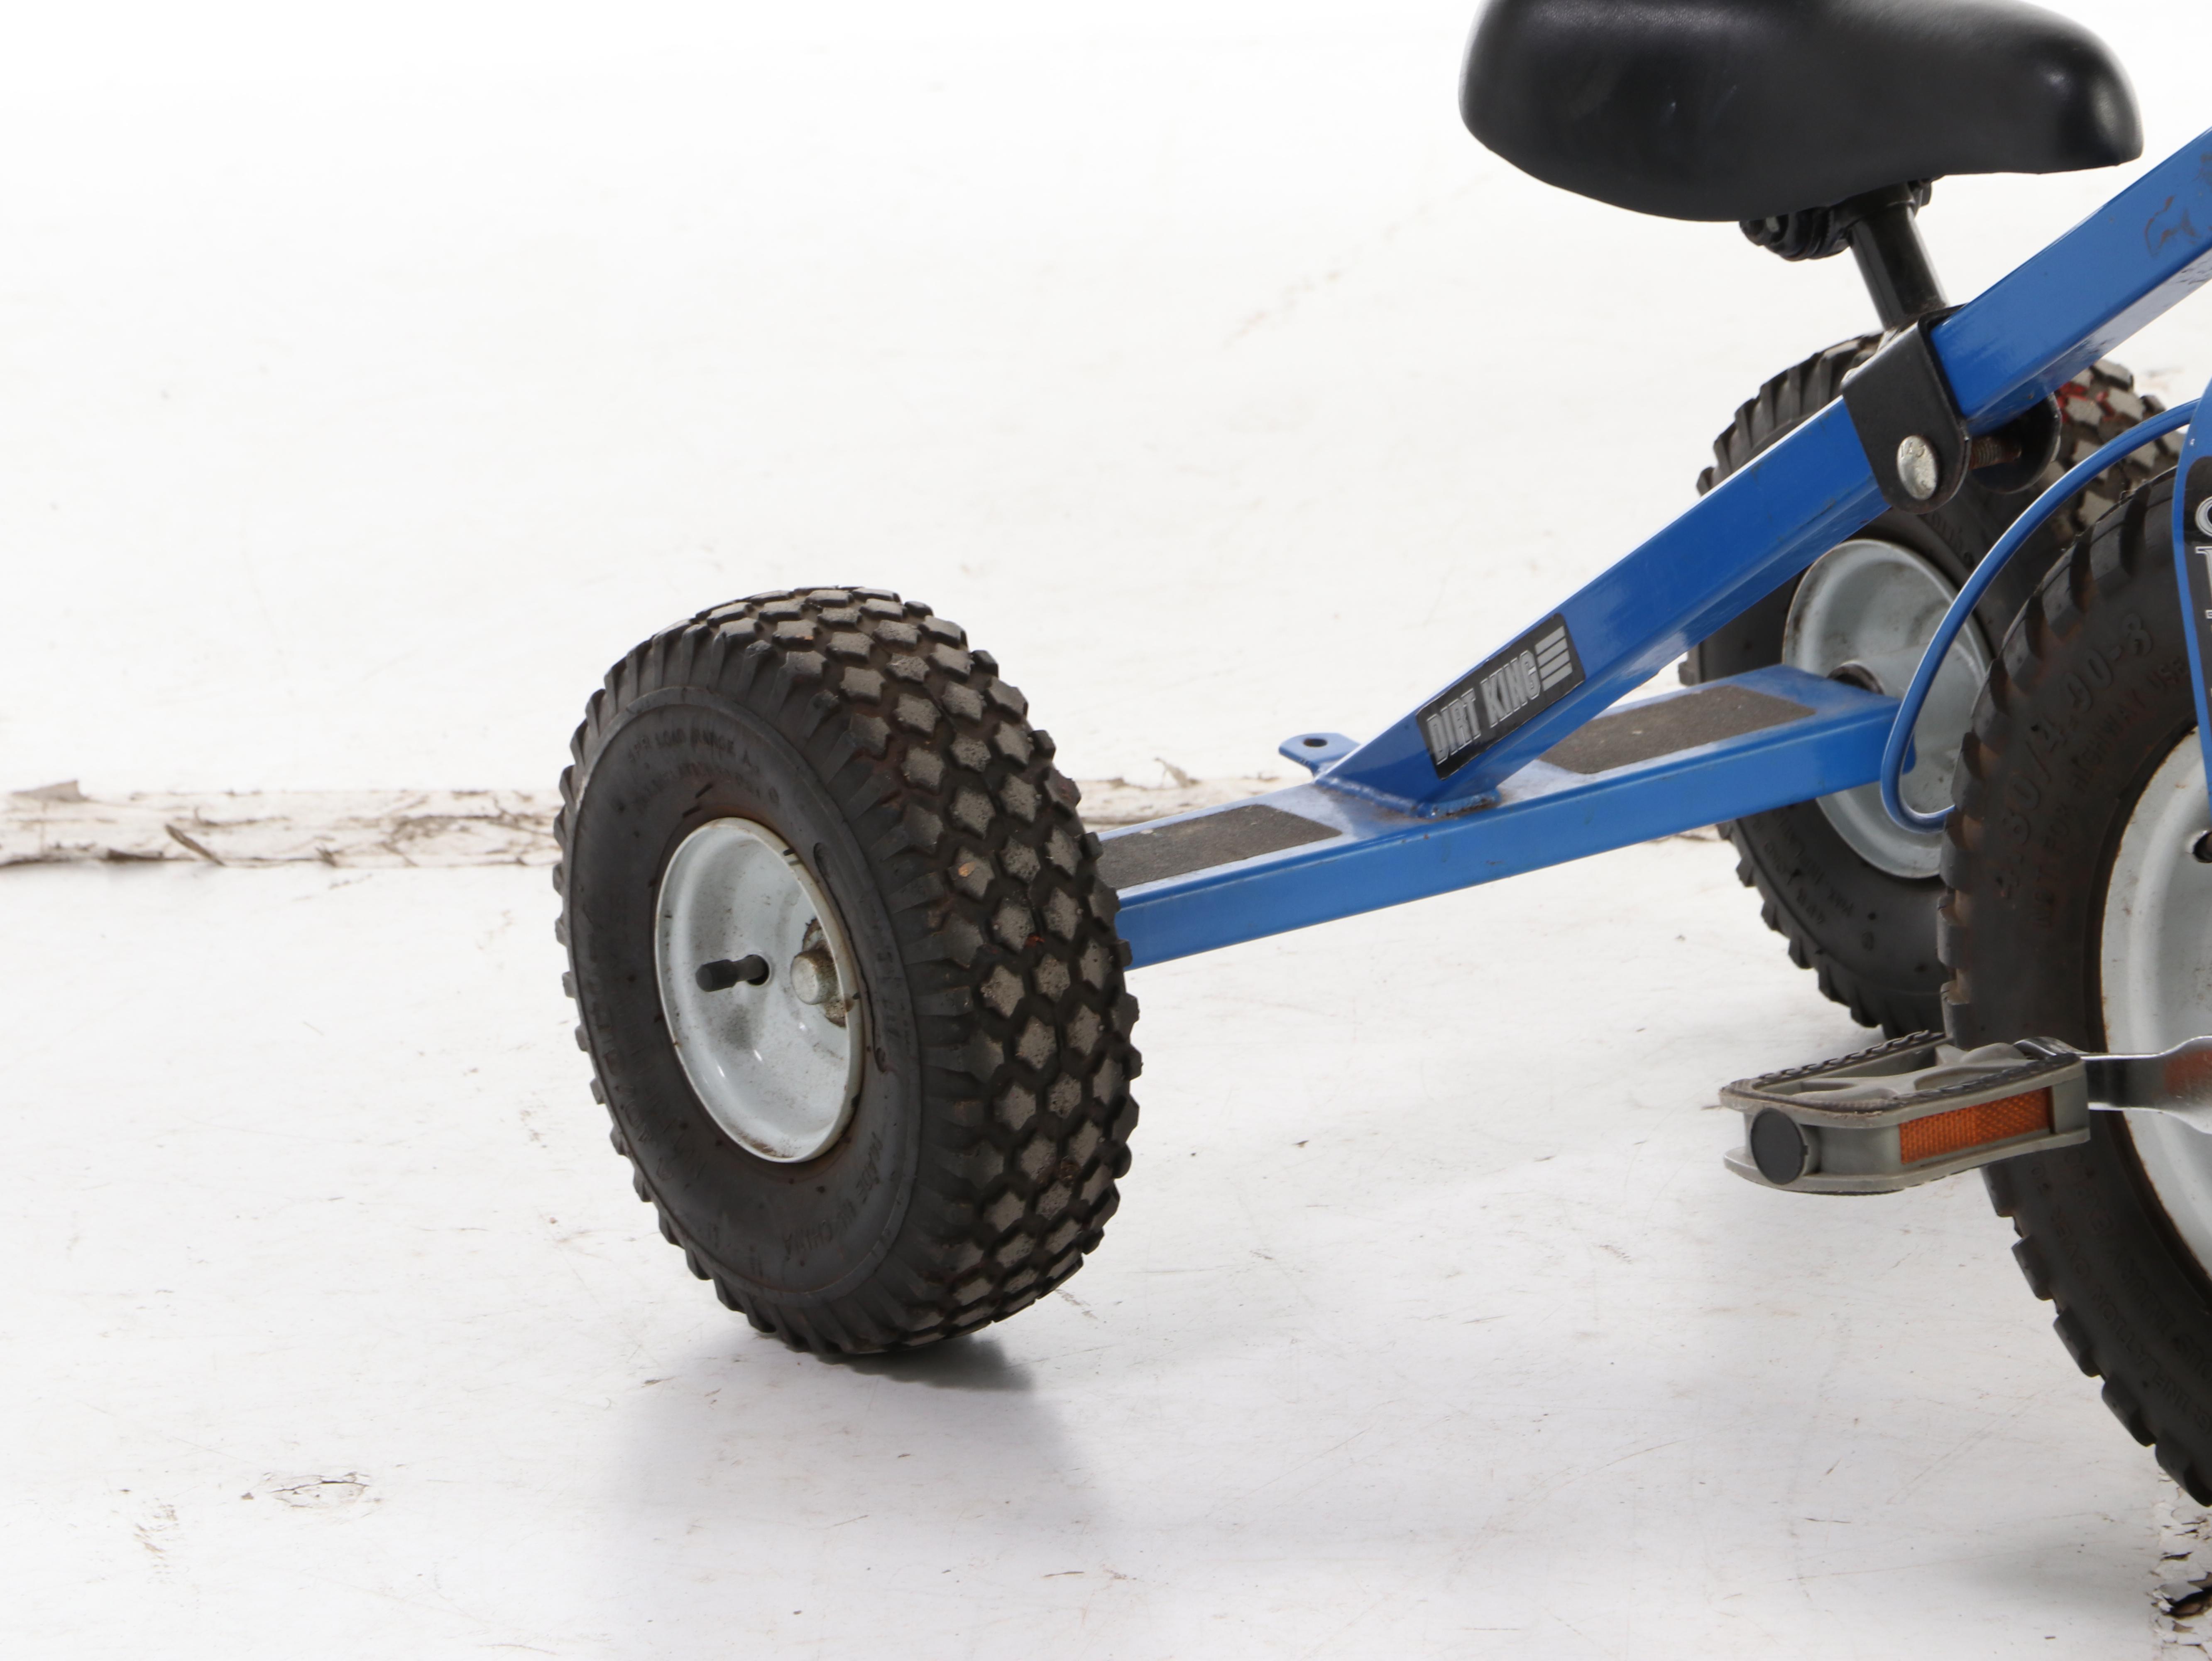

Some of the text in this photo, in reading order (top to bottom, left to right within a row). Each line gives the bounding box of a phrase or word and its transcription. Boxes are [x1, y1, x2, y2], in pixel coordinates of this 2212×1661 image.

[1427, 650, 1540, 765] DIRT KING
[2042, 802, 2077, 856] FOR
[2067, 689, 2146, 794] HIGHWAY
[2050, 1206, 2090, 1279] OVER
[2091, 1286, 2192, 1411] INFLATION
